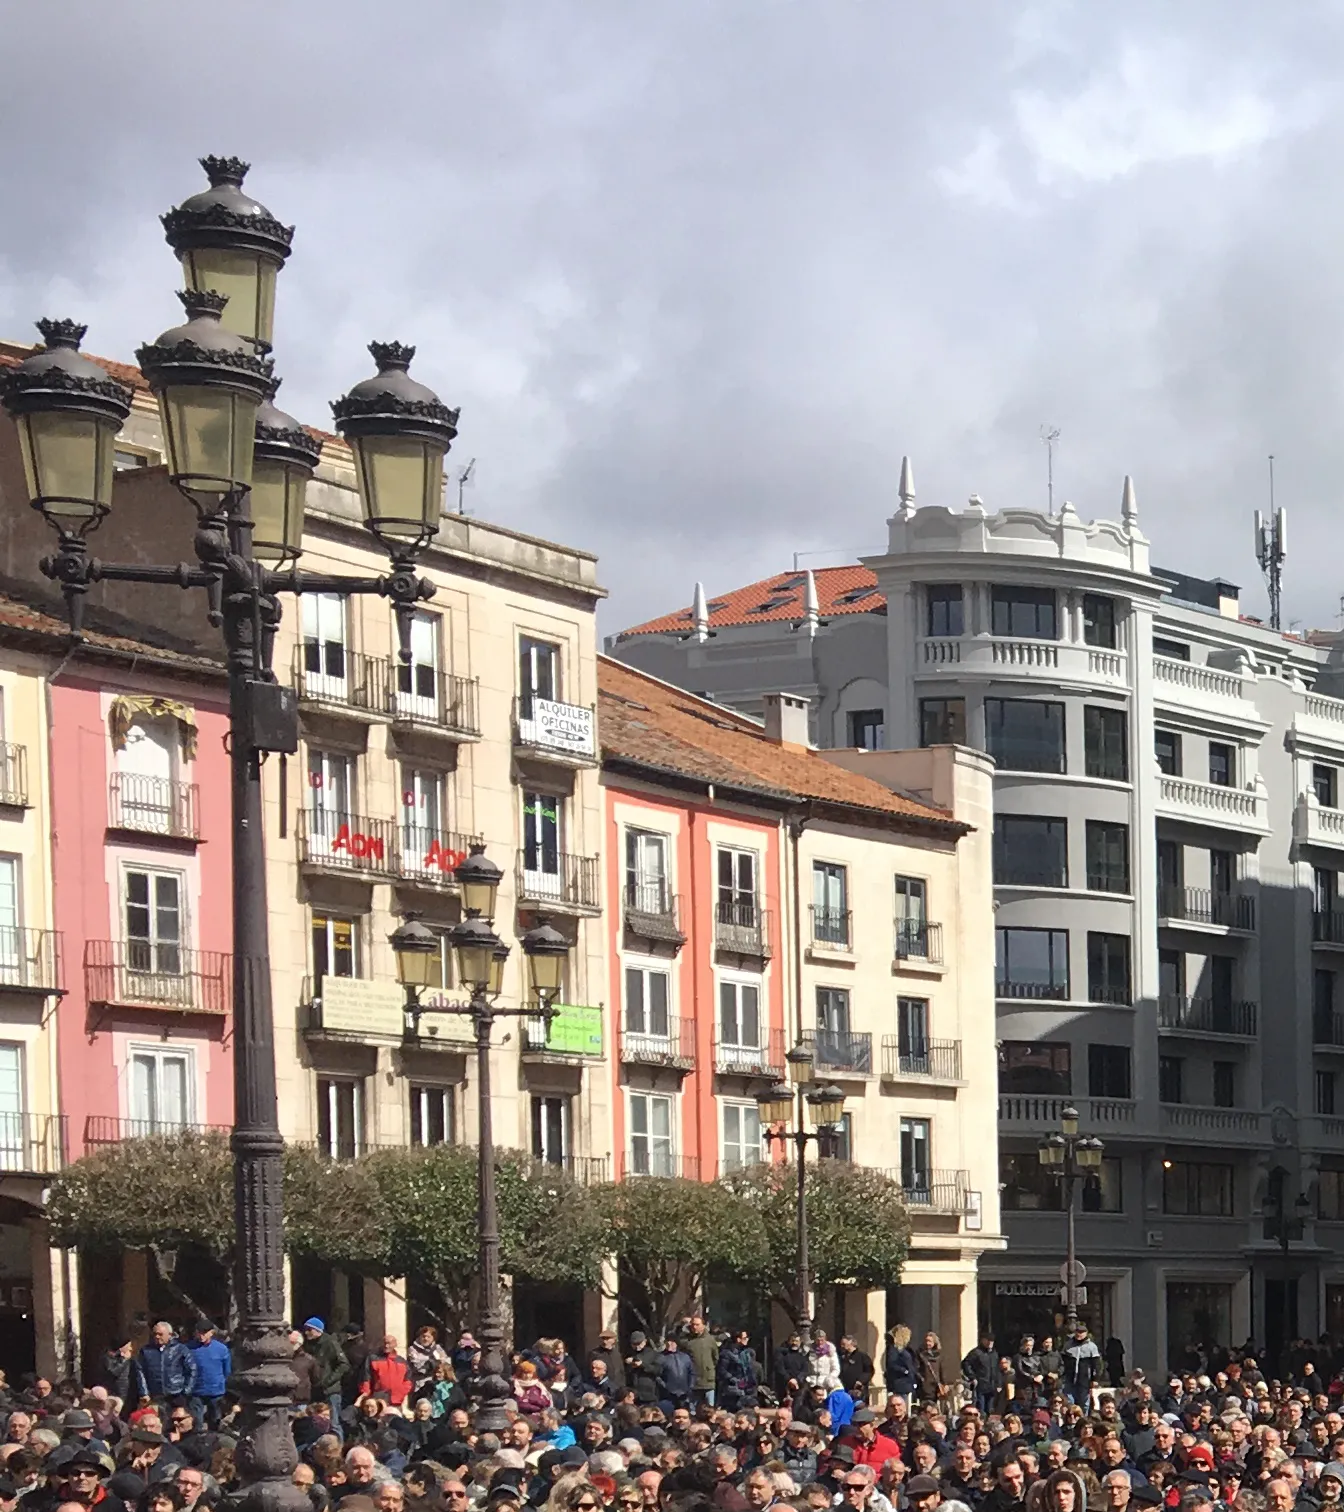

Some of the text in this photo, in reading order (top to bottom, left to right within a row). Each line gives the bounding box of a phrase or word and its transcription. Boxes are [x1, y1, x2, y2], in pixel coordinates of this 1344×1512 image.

[539, 701, 591, 721] ALQUILER
[541, 716, 590, 736] OFICINAS
[995, 1283, 1061, 1296] PULL&BEA
